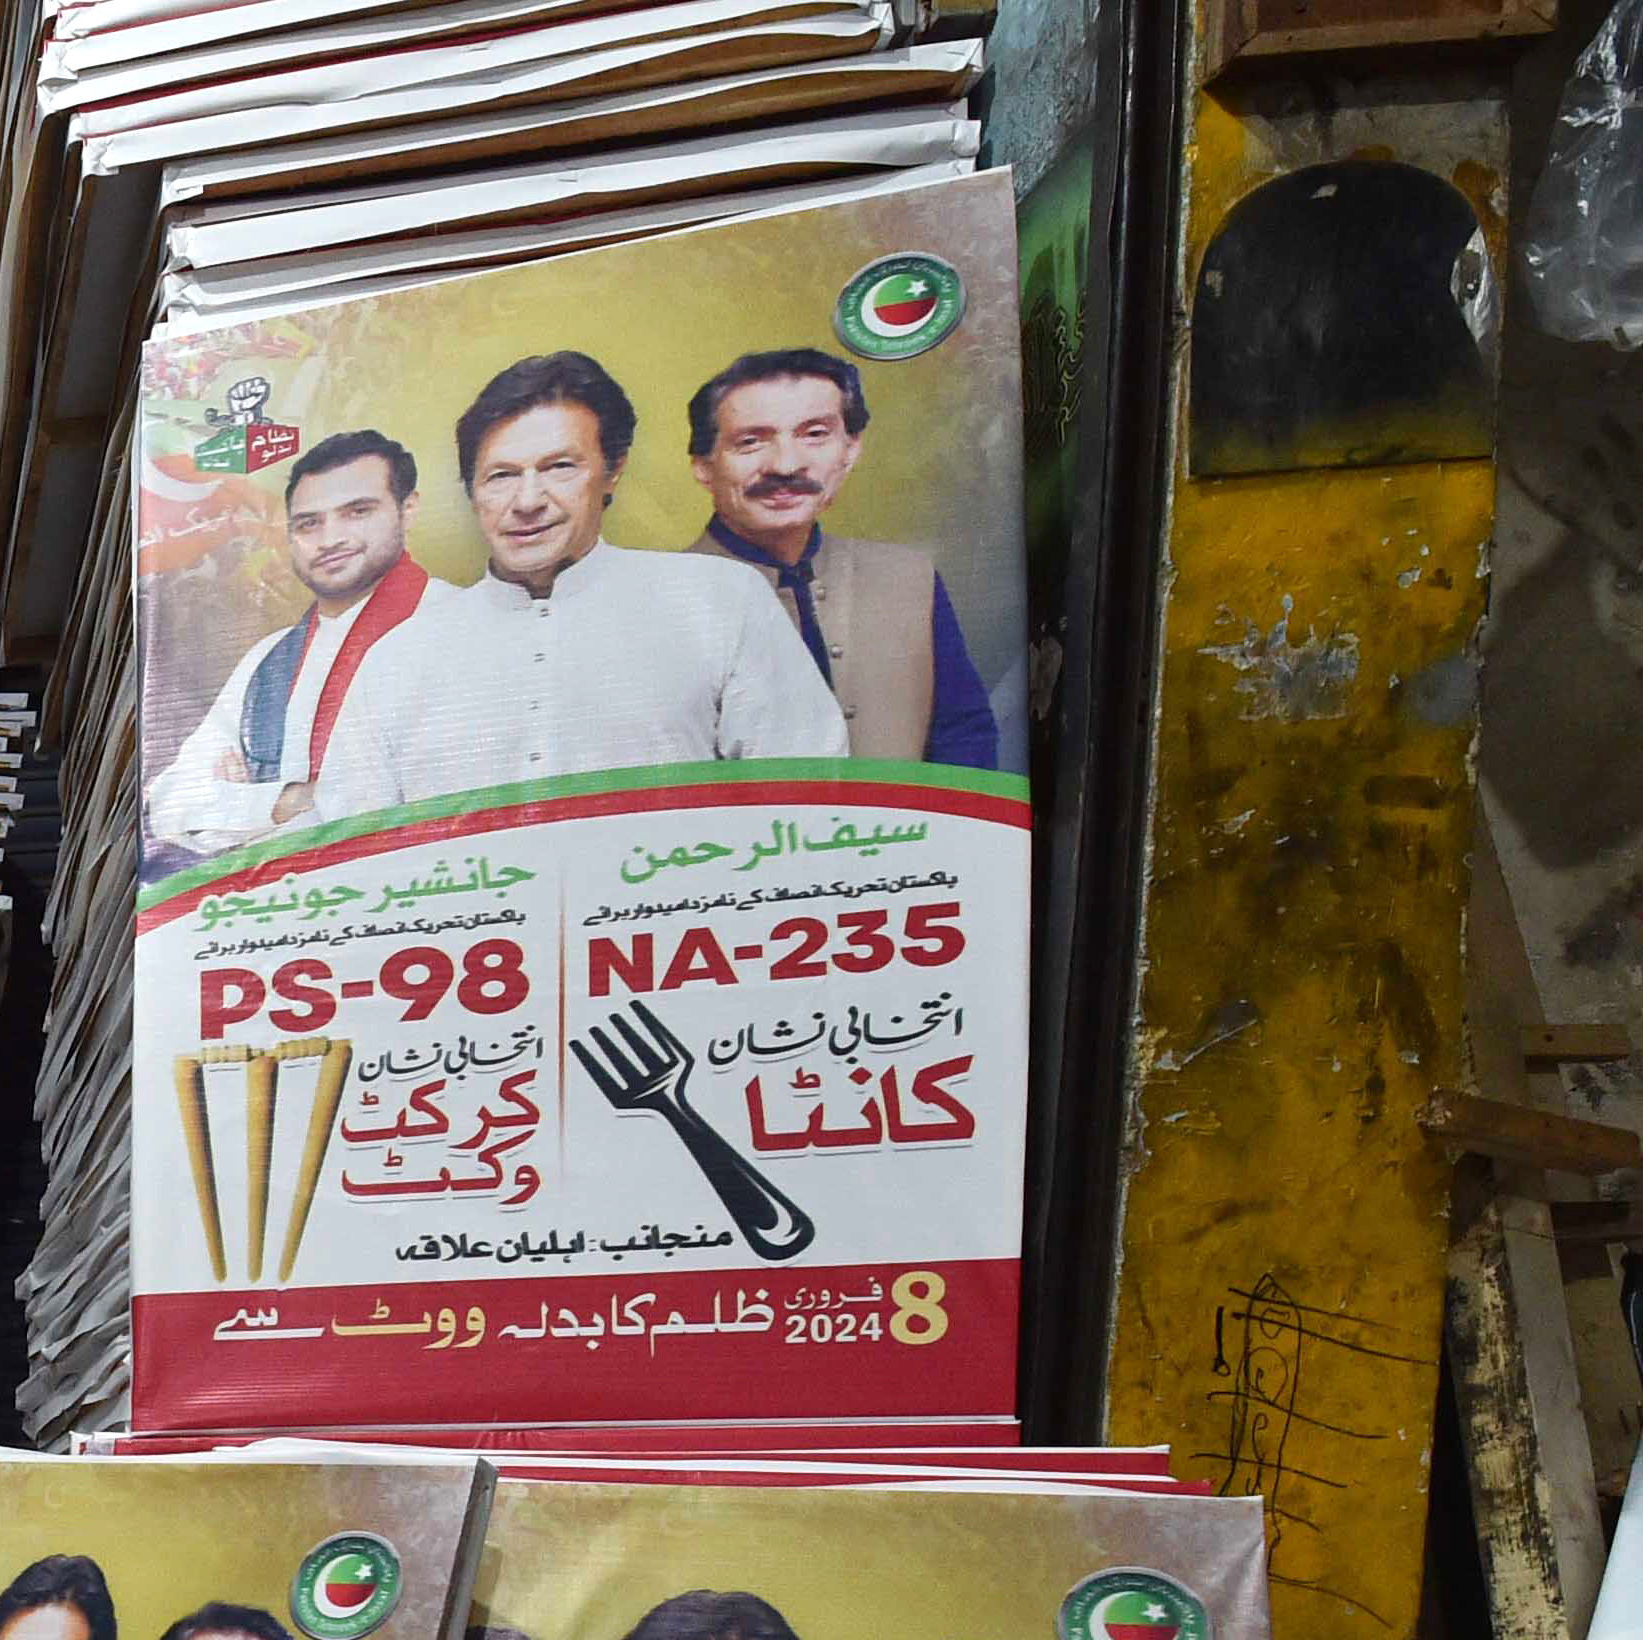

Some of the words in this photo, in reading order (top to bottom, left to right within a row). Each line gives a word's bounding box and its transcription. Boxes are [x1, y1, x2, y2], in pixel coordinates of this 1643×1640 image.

[373, 857, 535, 913] جانشیر
[589, 902, 967, 998] NA-235
[200, 938, 530, 1040] PS-98
[358, 1042, 446, 1083] نشان
[707, 1012, 826, 1066] نشان
[828, 991, 963, 1065] انتخابی
[746, 1055, 976, 1152] کانٹا
[785, 1312, 880, 1344] 2024
[889, 1270, 949, 1345] 8
